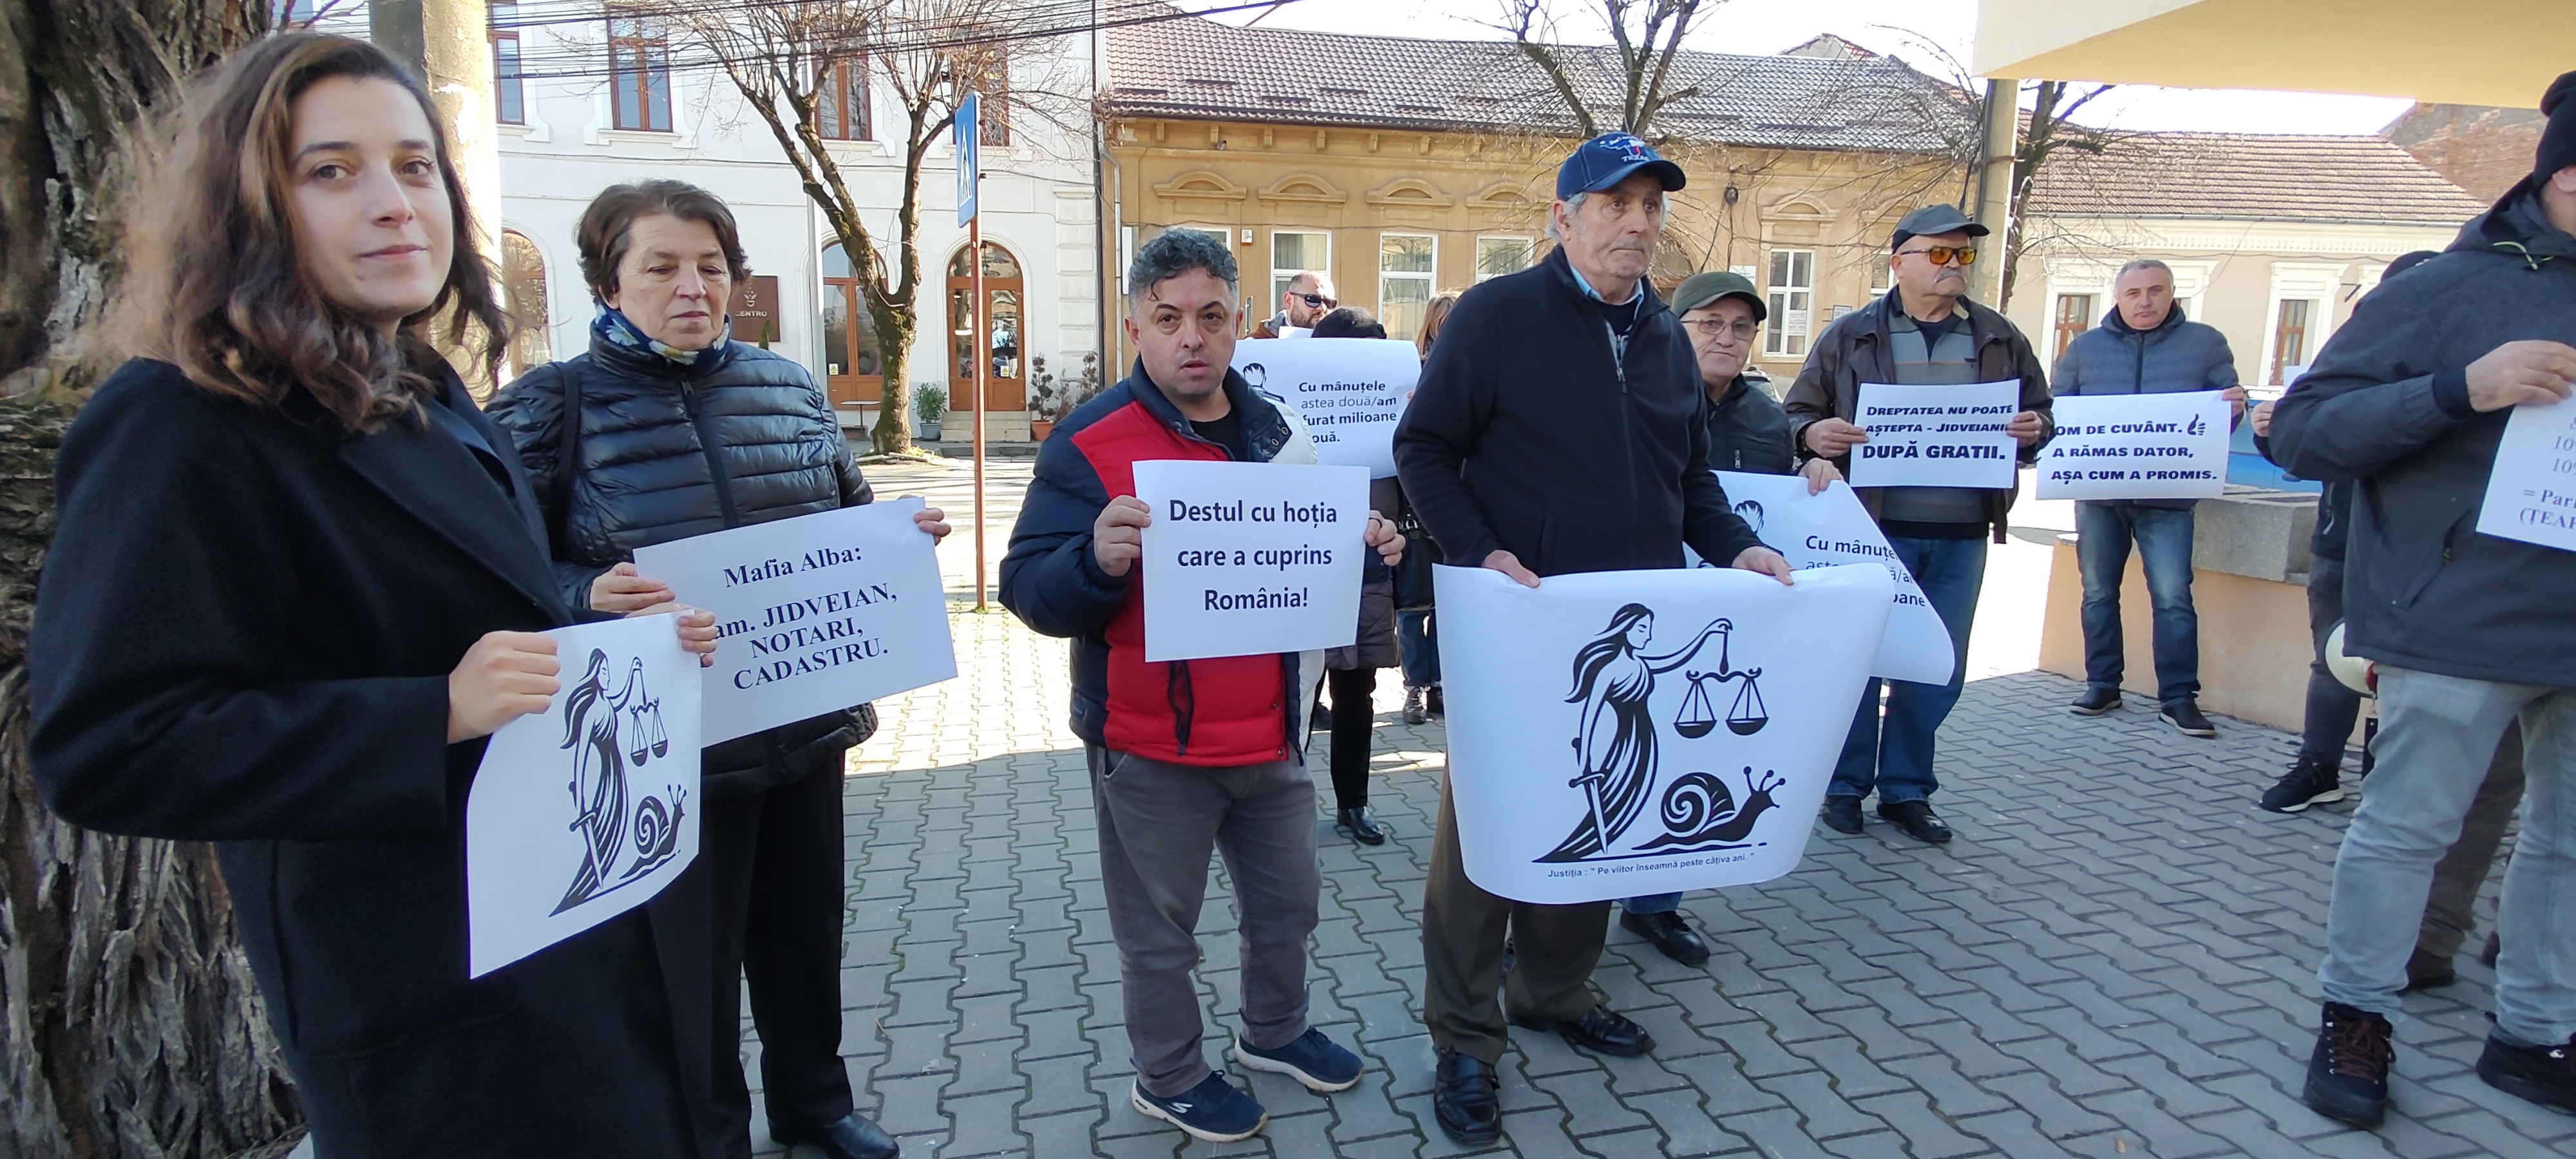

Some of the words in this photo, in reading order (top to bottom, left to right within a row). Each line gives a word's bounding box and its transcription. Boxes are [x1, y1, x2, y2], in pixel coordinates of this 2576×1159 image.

[1298, 382, 1316, 392] Cu
[1321, 381, 1386, 393] mânuțele
[1301, 398, 1334, 409] astea
[1338, 396, 1397, 408] două/am
[1866, 407, 1943, 416] DREPTATEA
[1971, 405, 2013, 415] POATE
[1339, 412, 1397, 424] milioane
[1865, 424, 1922, 437] AȘTEPTA
[2086, 426, 2105, 435] DE
[2110, 420, 2183, 433] CUVÂNT.
[1312, 431, 1340, 443] ouă.
[2553, 435, 2576, 451] 10
[1862, 440, 1918, 459] DUPĂ
[1926, 445, 2005, 460] GRATII.
[2052, 448, 2065, 458] A
[2070, 444, 2128, 457] RĂMAS
[2133, 447, 2193, 458] DATOR,
[2051, 471, 2083, 485] AȘA
[2088, 471, 2125, 480] CUM
[2129, 471, 2141, 480] A
[2146, 470, 2217, 480] PROMIS.
[1170, 499, 1243, 522] Destul
[1251, 506, 1275, 522] cu
[1283, 501, 1337, 529] hoția
[1177, 550, 1226, 566] care
[1234, 551, 1245, 565] a
[1253, 543, 1332, 571] cuprins
[1806, 536, 1828, 551] Cu
[1835, 540, 1898, 561] mânuțe
[722, 559, 794, 589] Mafia
[800, 547, 862, 572] Alba:
[1204, 587, 1308, 610] România!
[714, 619, 756, 639] am.
[763, 582, 897, 628] JIDVEIAN,
[748, 617, 864, 659] NOTARI,
[733, 637, 889, 690] CADASTRU.
[1548, 869, 1582, 878] Justiția
[1611, 865, 1634, 873] viitor
[1636, 860, 1678, 872] înseamnă
[1680, 858, 1703, 869] peste
[1705, 855, 1730, 865] câțiva
[1732, 853, 1748, 862] ani.
